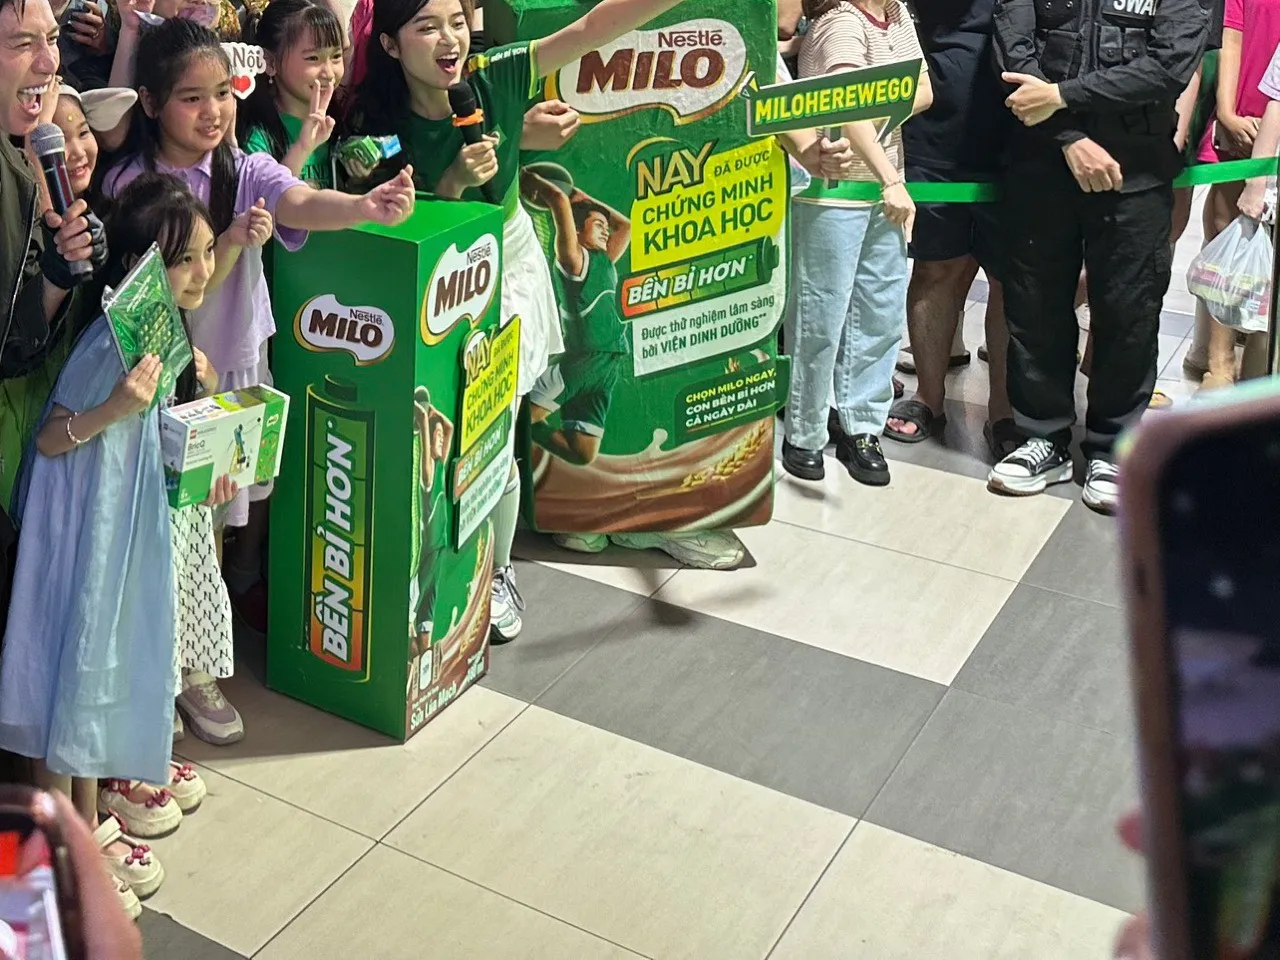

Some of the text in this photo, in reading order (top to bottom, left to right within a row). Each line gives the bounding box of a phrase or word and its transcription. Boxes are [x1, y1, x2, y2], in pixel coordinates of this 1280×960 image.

[231, 45, 266, 73] Nội
[657, 26, 726, 49] Nestlé
[575, 46, 726, 95] MILO
[754, 75, 915, 125] MILOHEREWEGO
[636, 138, 718, 200] NAY
[713, 149, 771, 177] ĐÃ ĐƯỢC
[642, 171, 774, 225] CHỨNG MINH
[643, 197, 774, 256] KHOA HỌC
[466, 241, 492, 266] Nestlé
[433, 259, 491, 318] MILO
[627, 256, 747, 306] BỀN BỈ HƠN
[308, 308, 384, 348] MILO
[349, 308, 384, 326] Nestlé
[640, 294, 775, 341] Được thử nghiệm lâm sàng
[465, 323, 498, 389] NAY
[642, 341, 658, 360] bởi
[660, 334, 688, 355] VIỆN
[689, 327, 718, 346] DINH
[466, 369, 495, 411] CHỨNG
[496, 347, 515, 377] MINH
[685, 387, 717, 404] CHỌN
[717, 378, 744, 395] MILO
[685, 400, 711, 416] CON
[750, 379, 776, 396] HƠN
[465, 392, 494, 439] KHOA
[493, 369, 514, 409] HỌC
[685, 398, 757, 428] CẢ NGÀY DÀI
[314, 432, 353, 663] BỀN BỈ HƠN
[424, 697, 438, 719] Lúa
